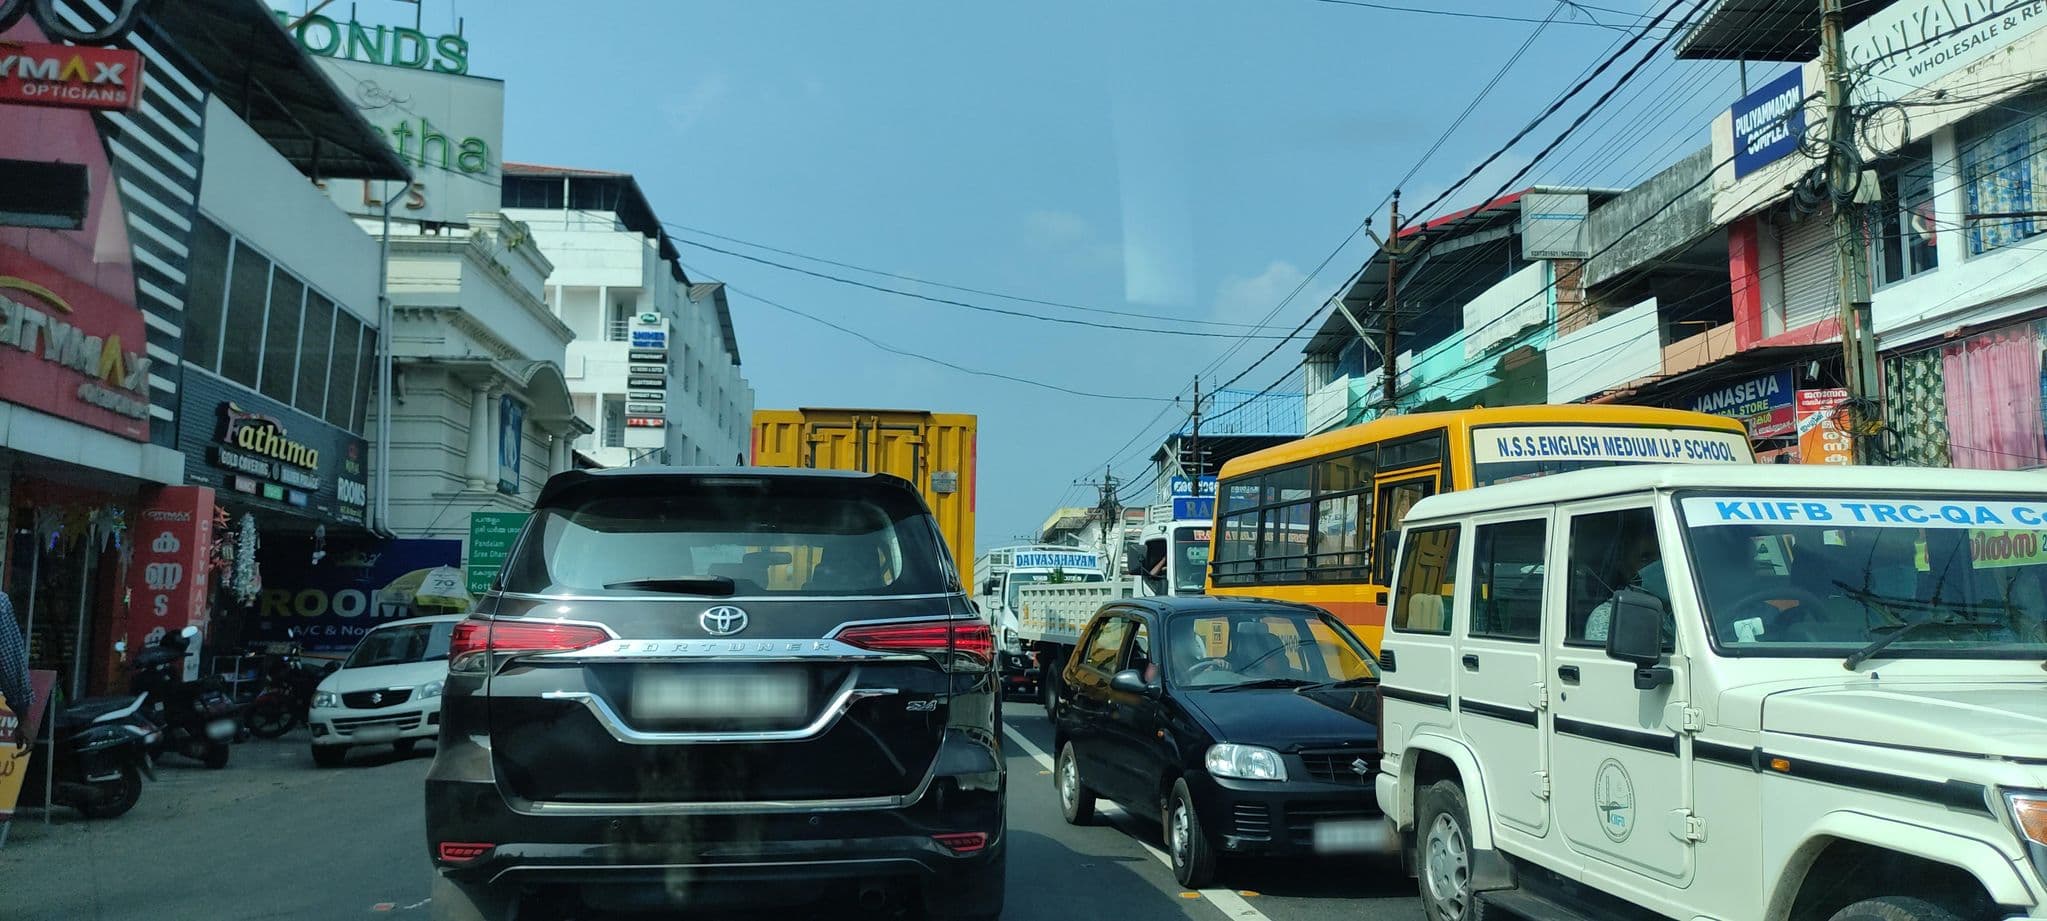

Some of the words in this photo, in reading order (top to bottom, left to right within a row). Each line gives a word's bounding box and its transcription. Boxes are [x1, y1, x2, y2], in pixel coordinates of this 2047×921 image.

[276, 10, 469, 75] ONDS
[1908, 24, 1998, 78] WHOLESALE
[2002, 17, 2018, 31] &
[2022, 0, 2046, 21] RE
[23, 82, 127, 103] OPTICIANS
[1736, 85, 1799, 138] PULIYAMMADOM
[370, 118, 489, 174] tha
[1747, 119, 1789, 155] COMPLEX
[1692, 374, 1779, 412] JANASEVA
[1739, 399, 1769, 416] STORE
[224, 402, 319, 470] Fathima
[1497, 435, 1599, 457] N.S.S.ENGLISH
[1605, 436, 1660, 458] MEDIUM
[1684, 439, 1736, 462] SCHOOL
[337, 477, 365, 507] ROOMS
[1185, 501, 1214, 517] RA
[1715, 501, 1832, 521] KIIFB
[1841, 503, 2004, 525] TRC-QA
[1016, 553, 1096, 568] DAIVASAHAYAM
[471, 582, 491, 591] Kott
[261, 588, 408, 618] ROOM
[613, 640, 834, 653] FORTUNER
